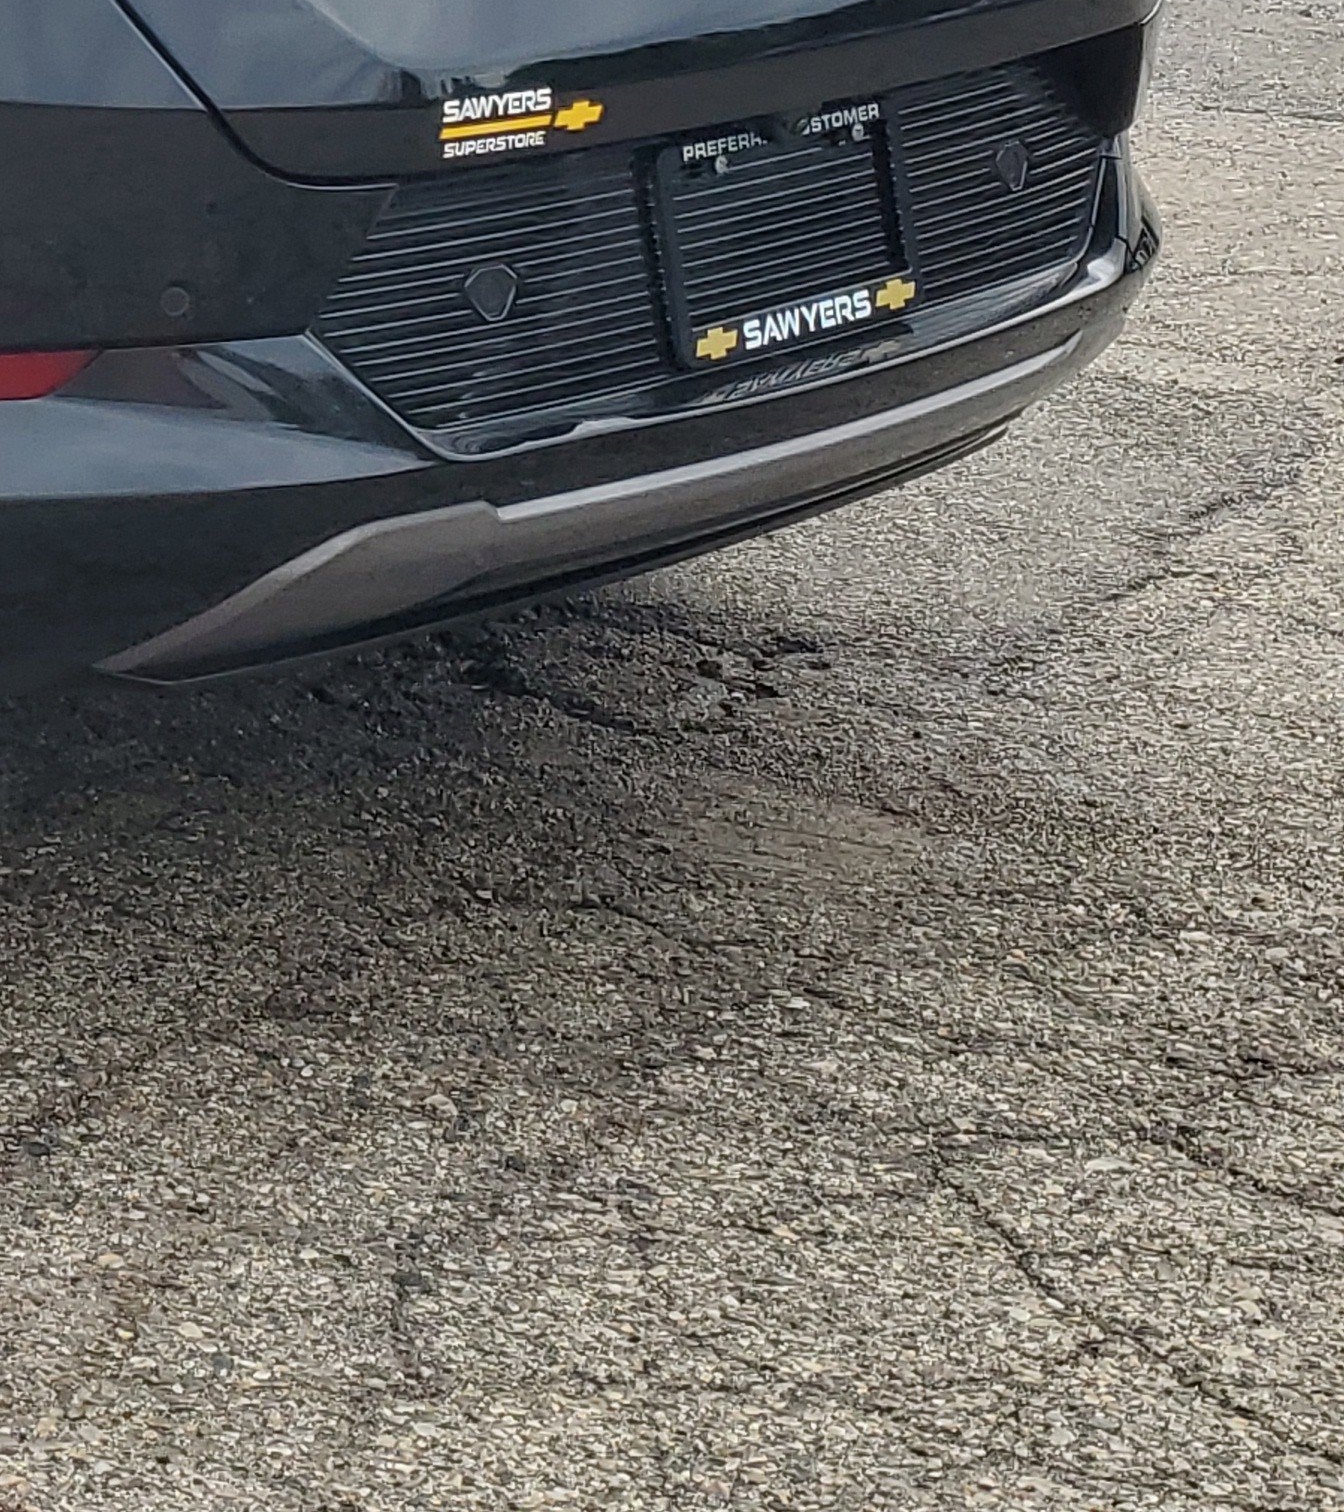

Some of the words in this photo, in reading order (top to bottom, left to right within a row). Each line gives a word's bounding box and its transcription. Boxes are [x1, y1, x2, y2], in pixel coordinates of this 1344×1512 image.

[442, 87, 553, 123] SAWYERS
[796, 102, 880, 136] STOMER
[442, 130, 547, 159] SUPERSTORE
[742, 288, 873, 351] SAWYERS
